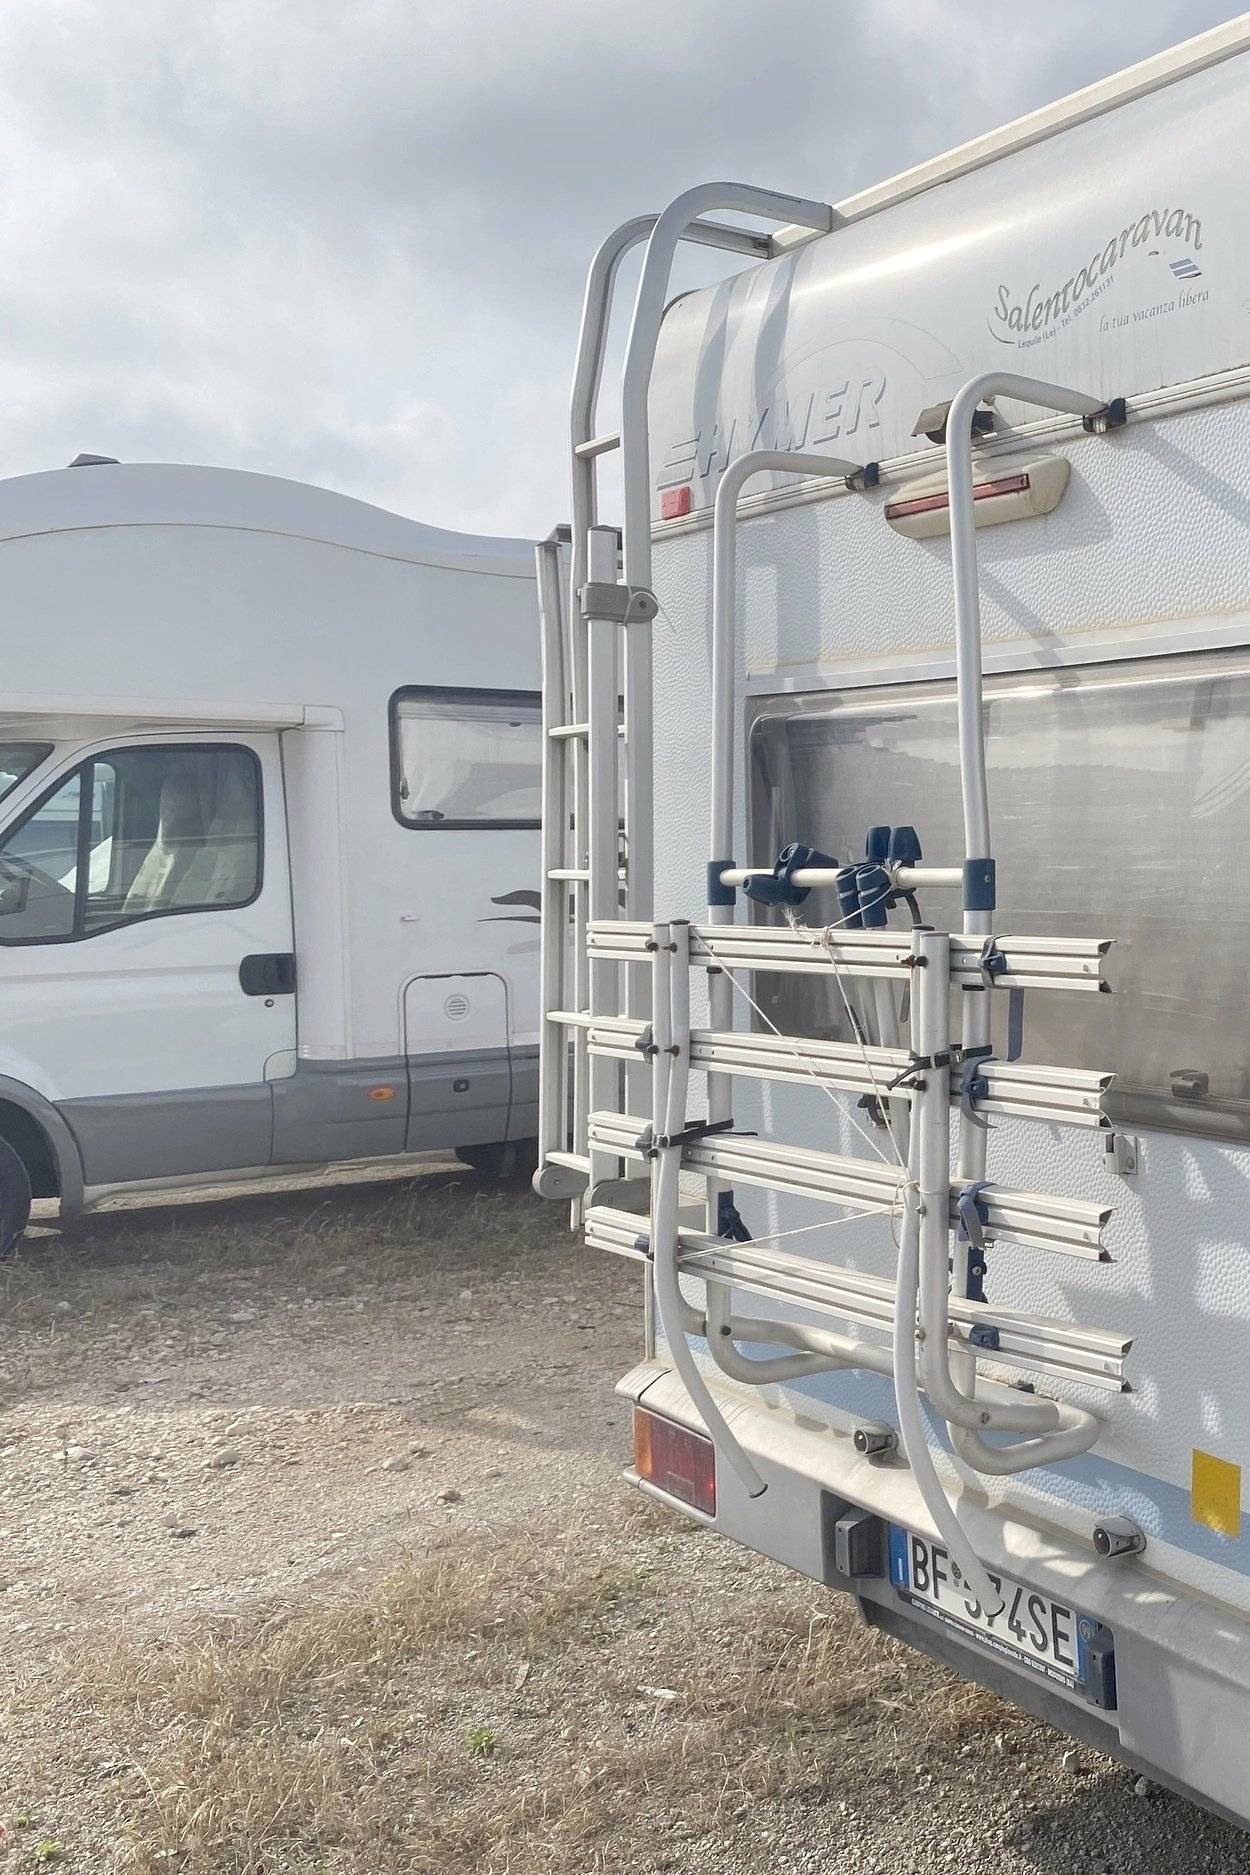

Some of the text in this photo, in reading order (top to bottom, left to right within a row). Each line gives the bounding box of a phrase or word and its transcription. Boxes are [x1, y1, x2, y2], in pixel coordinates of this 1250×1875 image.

[1112, 315, 1129, 329] tua
[1132, 301, 1175, 323] vacanza
[1179, 288, 1209, 308] libera
[911, 1535, 948, 1600] BF
